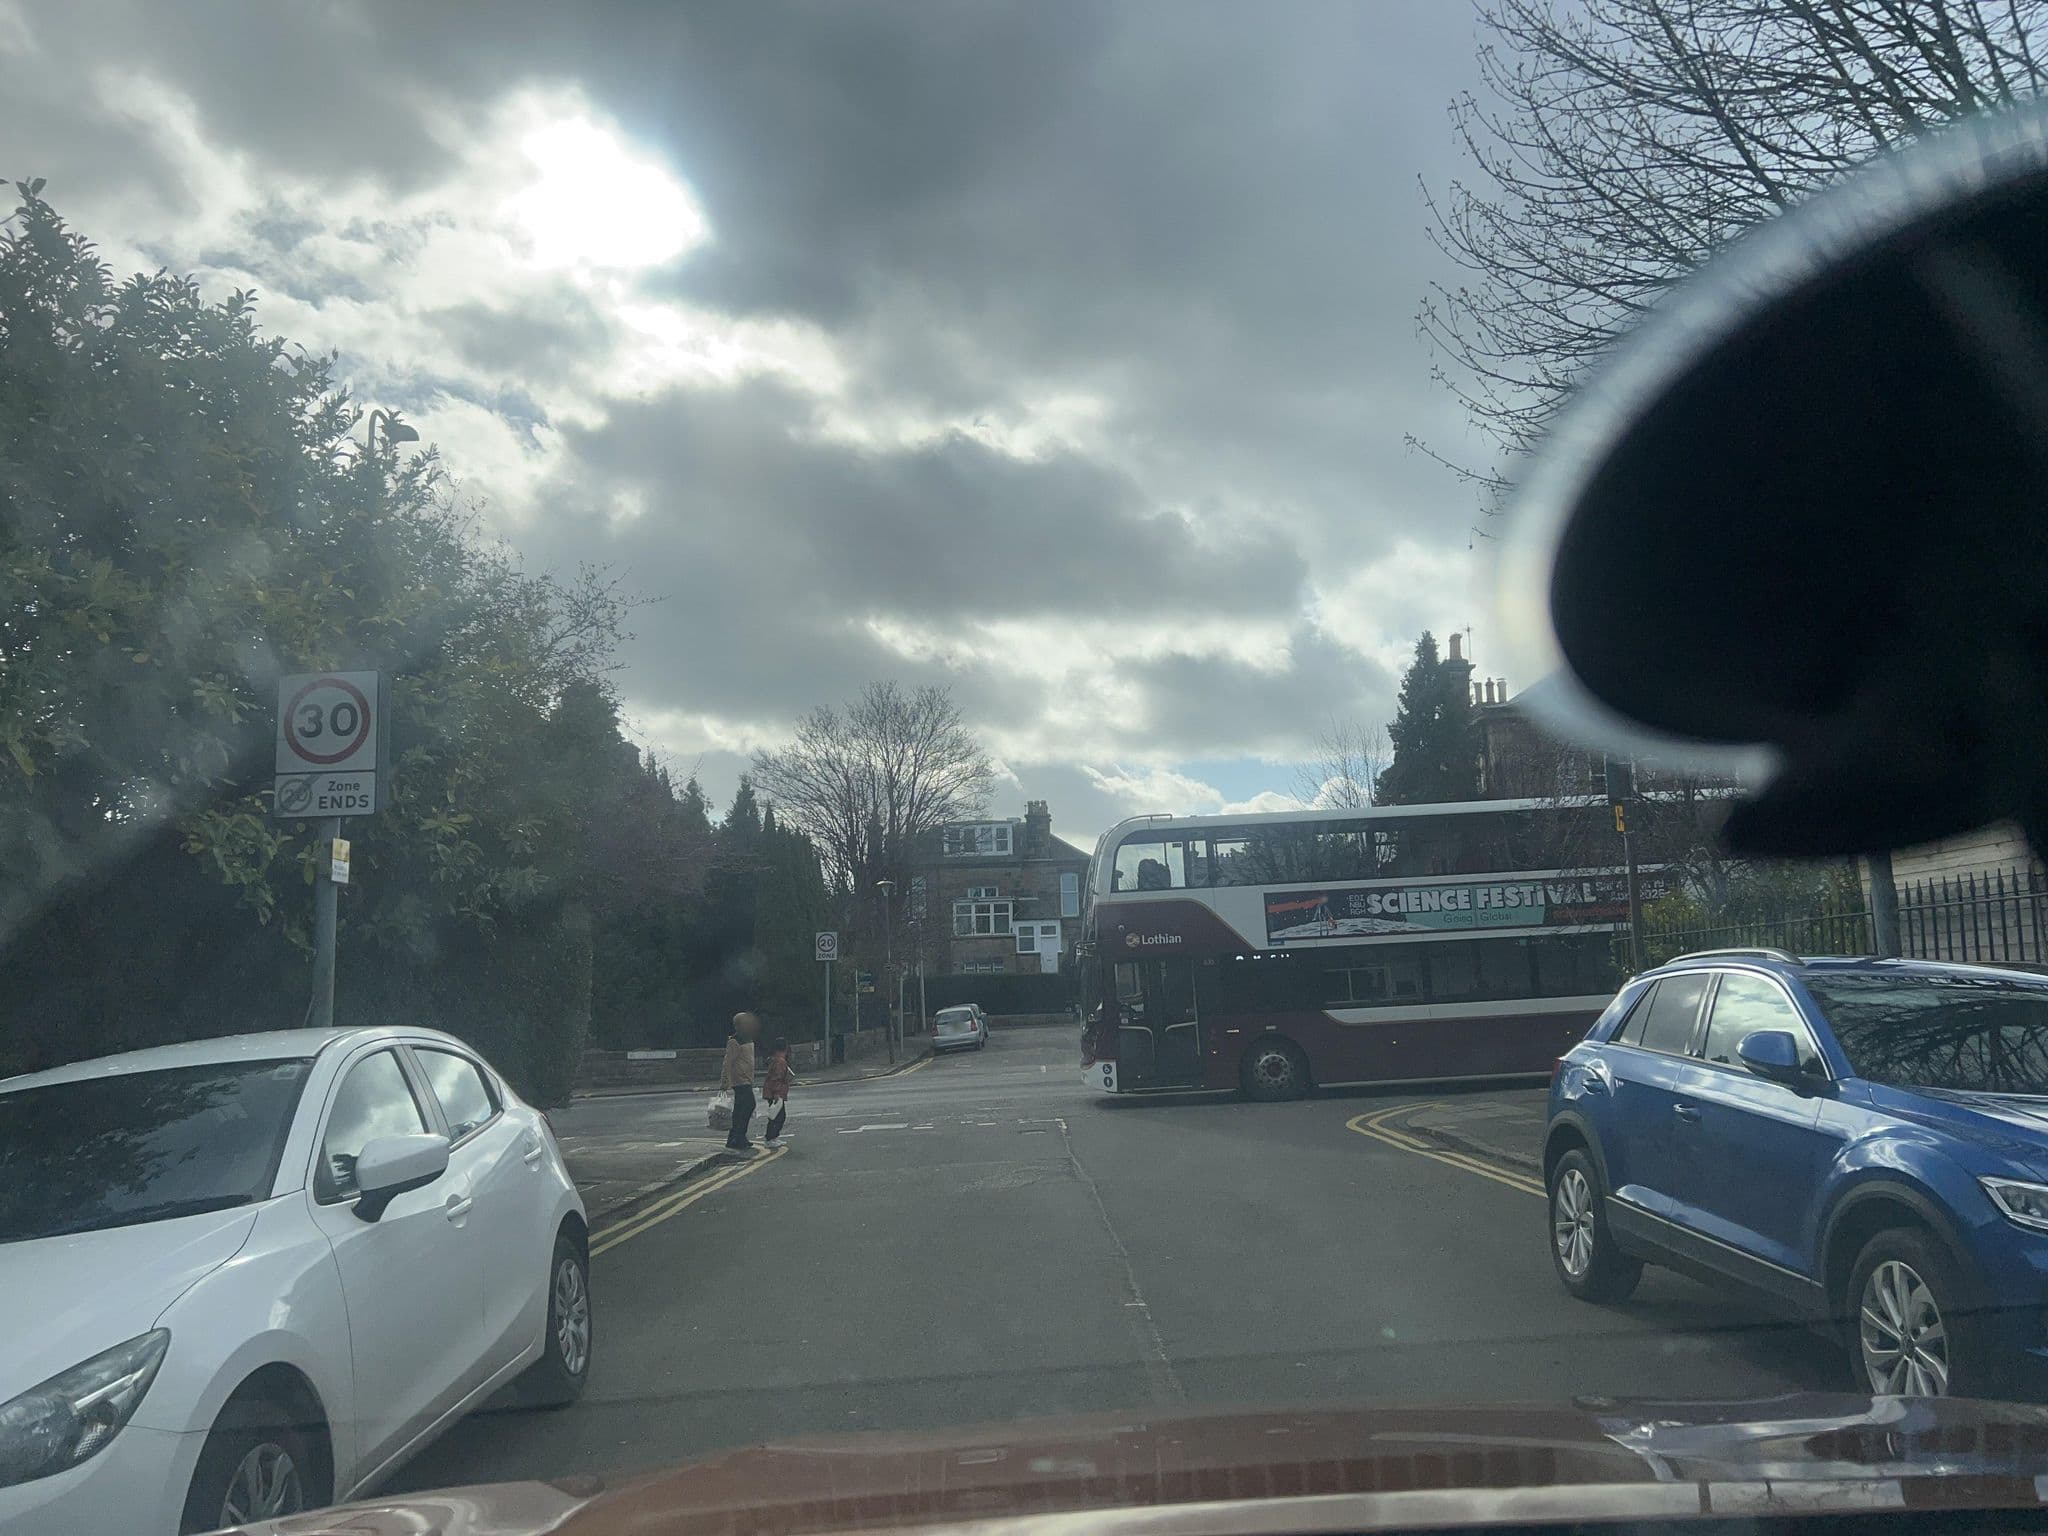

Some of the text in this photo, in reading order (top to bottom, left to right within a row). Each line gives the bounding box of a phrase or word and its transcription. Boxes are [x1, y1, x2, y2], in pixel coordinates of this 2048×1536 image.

[298, 702, 358, 738] 30
[328, 780, 361, 792] Zone
[319, 794, 369, 810] ENDS
[1366, 888, 1471, 914] SCIENCE
[1443, 911, 1512, 923] Going Global
[820, 939, 833, 947] 20
[1142, 933, 1182, 945] Lothian
